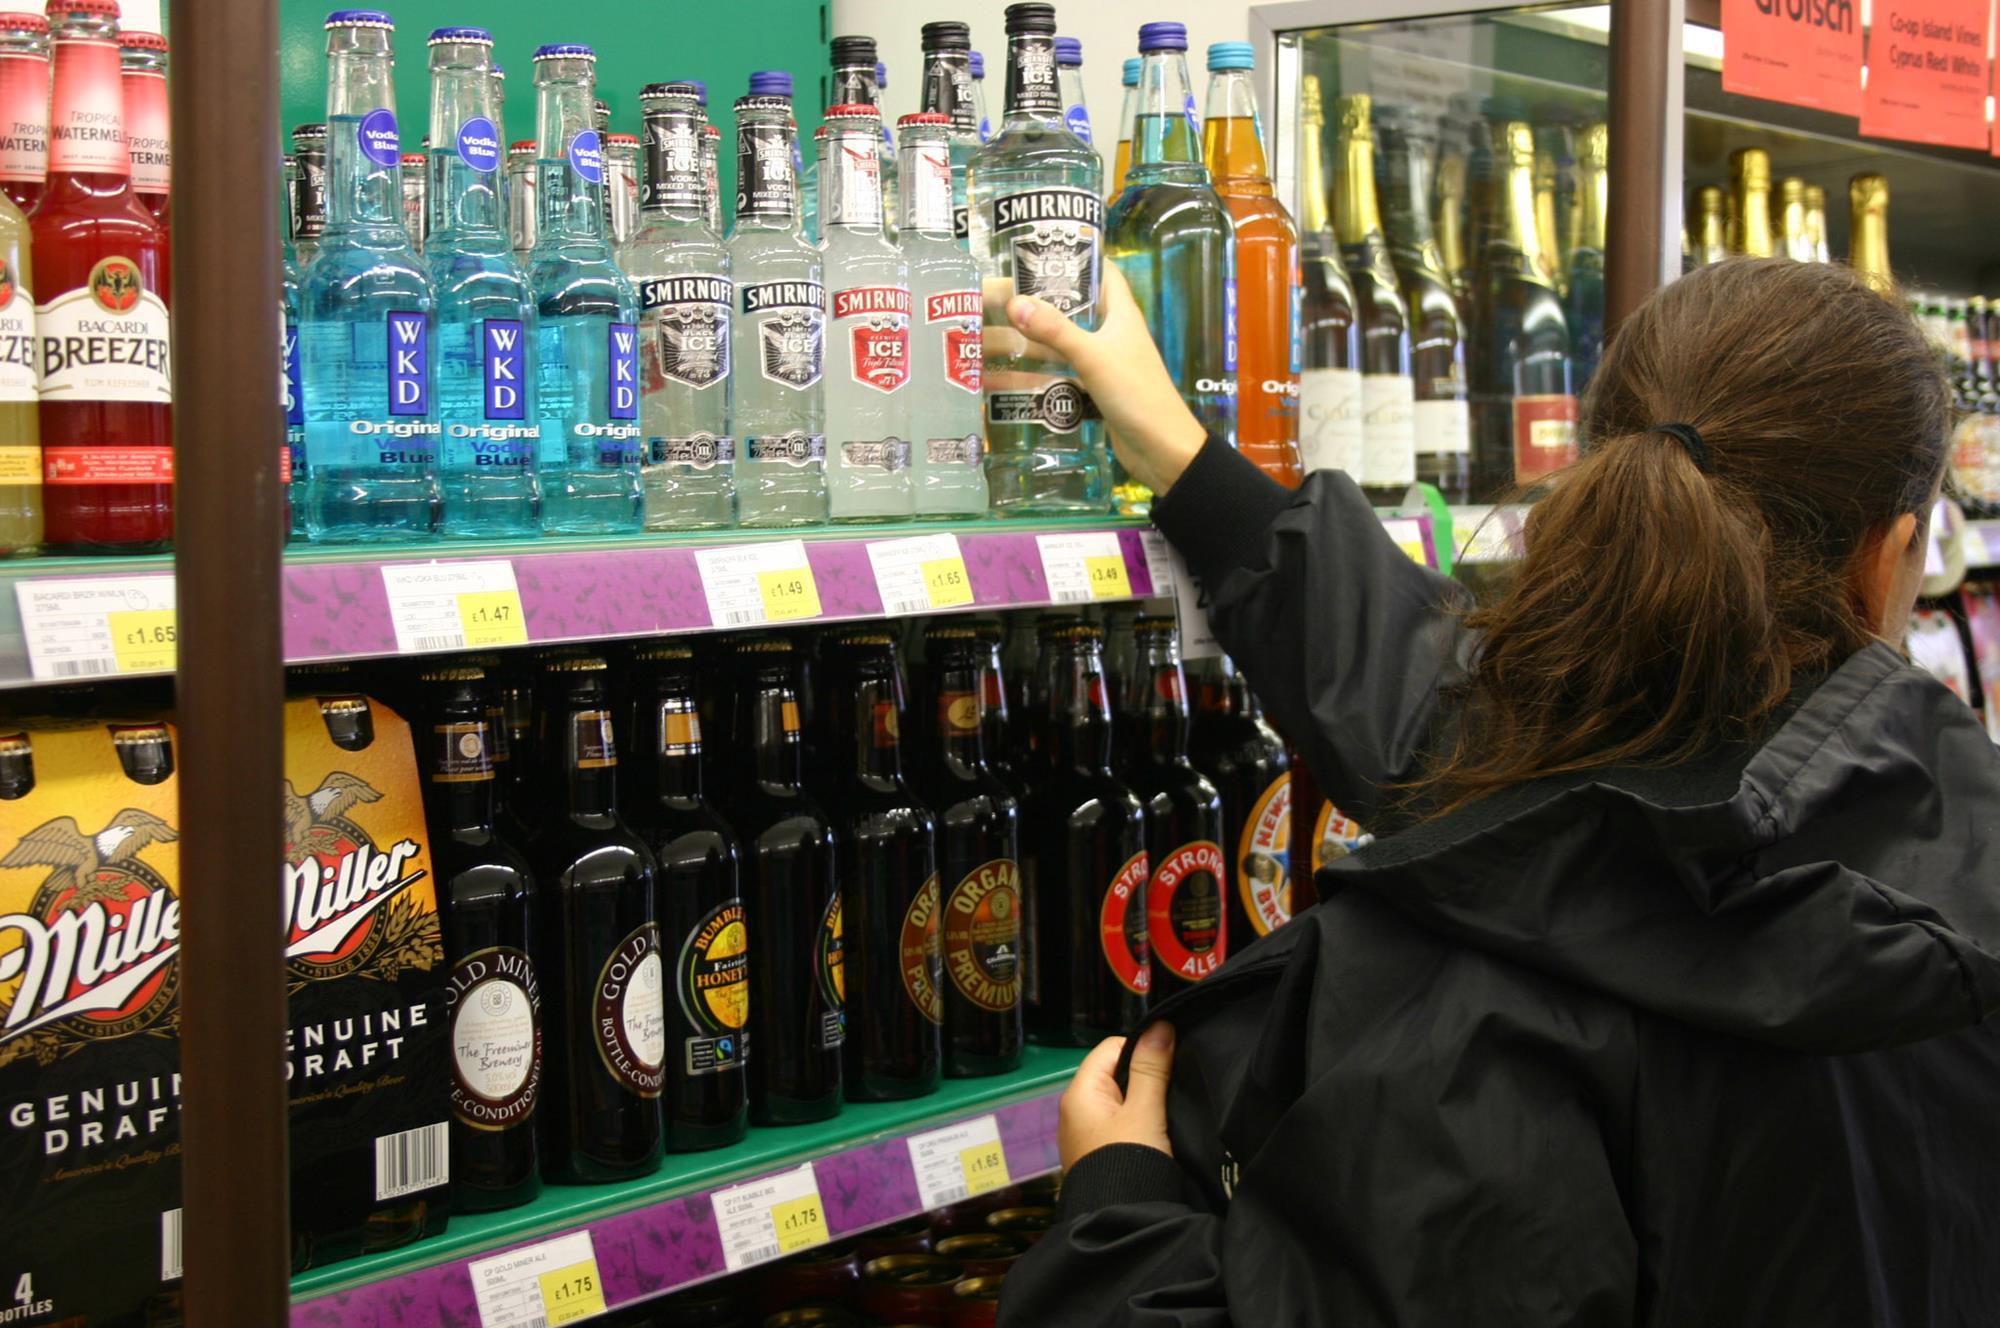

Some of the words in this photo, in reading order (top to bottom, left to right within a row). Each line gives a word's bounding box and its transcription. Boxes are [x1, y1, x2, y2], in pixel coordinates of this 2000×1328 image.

[998, 194, 1101, 225] SMIRNOFF
[645, 278, 733, 306] SMIRNOFF
[78, 319, 149, 335] BACARDI
[681, 336, 717, 351] ICE
[783, 339, 813, 353] ICE
[867, 341, 903, 357] ICE
[43, 336, 169, 380] BREEZER
[394, 320, 422, 405] WKD
[490, 328, 518, 410] WKD
[614, 331, 634, 410] WKD
[448, 424, 540, 440] Original
[380, 452, 435, 464] Blue
[475, 454, 532, 467] Blue
[932, 571, 961, 588] £1.65
[1092, 568, 1118, 581] £3.49
[771, 581, 803, 598] £1.49
[472, 606, 510, 623] £1.47
[128, 626, 177, 645] £1.65
[1159, 848, 1224, 886] STRONG
[602, 935, 647, 1000] GOLD
[1181, 952, 1217, 975] ALE
[44, 1103, 183, 1155] DRAF
[971, 1153, 999, 1172] £1.65
[785, 1208, 817, 1230] £1.75
[14, 1272, 34, 1305] 4
[556, 1276, 593, 1300] £1.75
